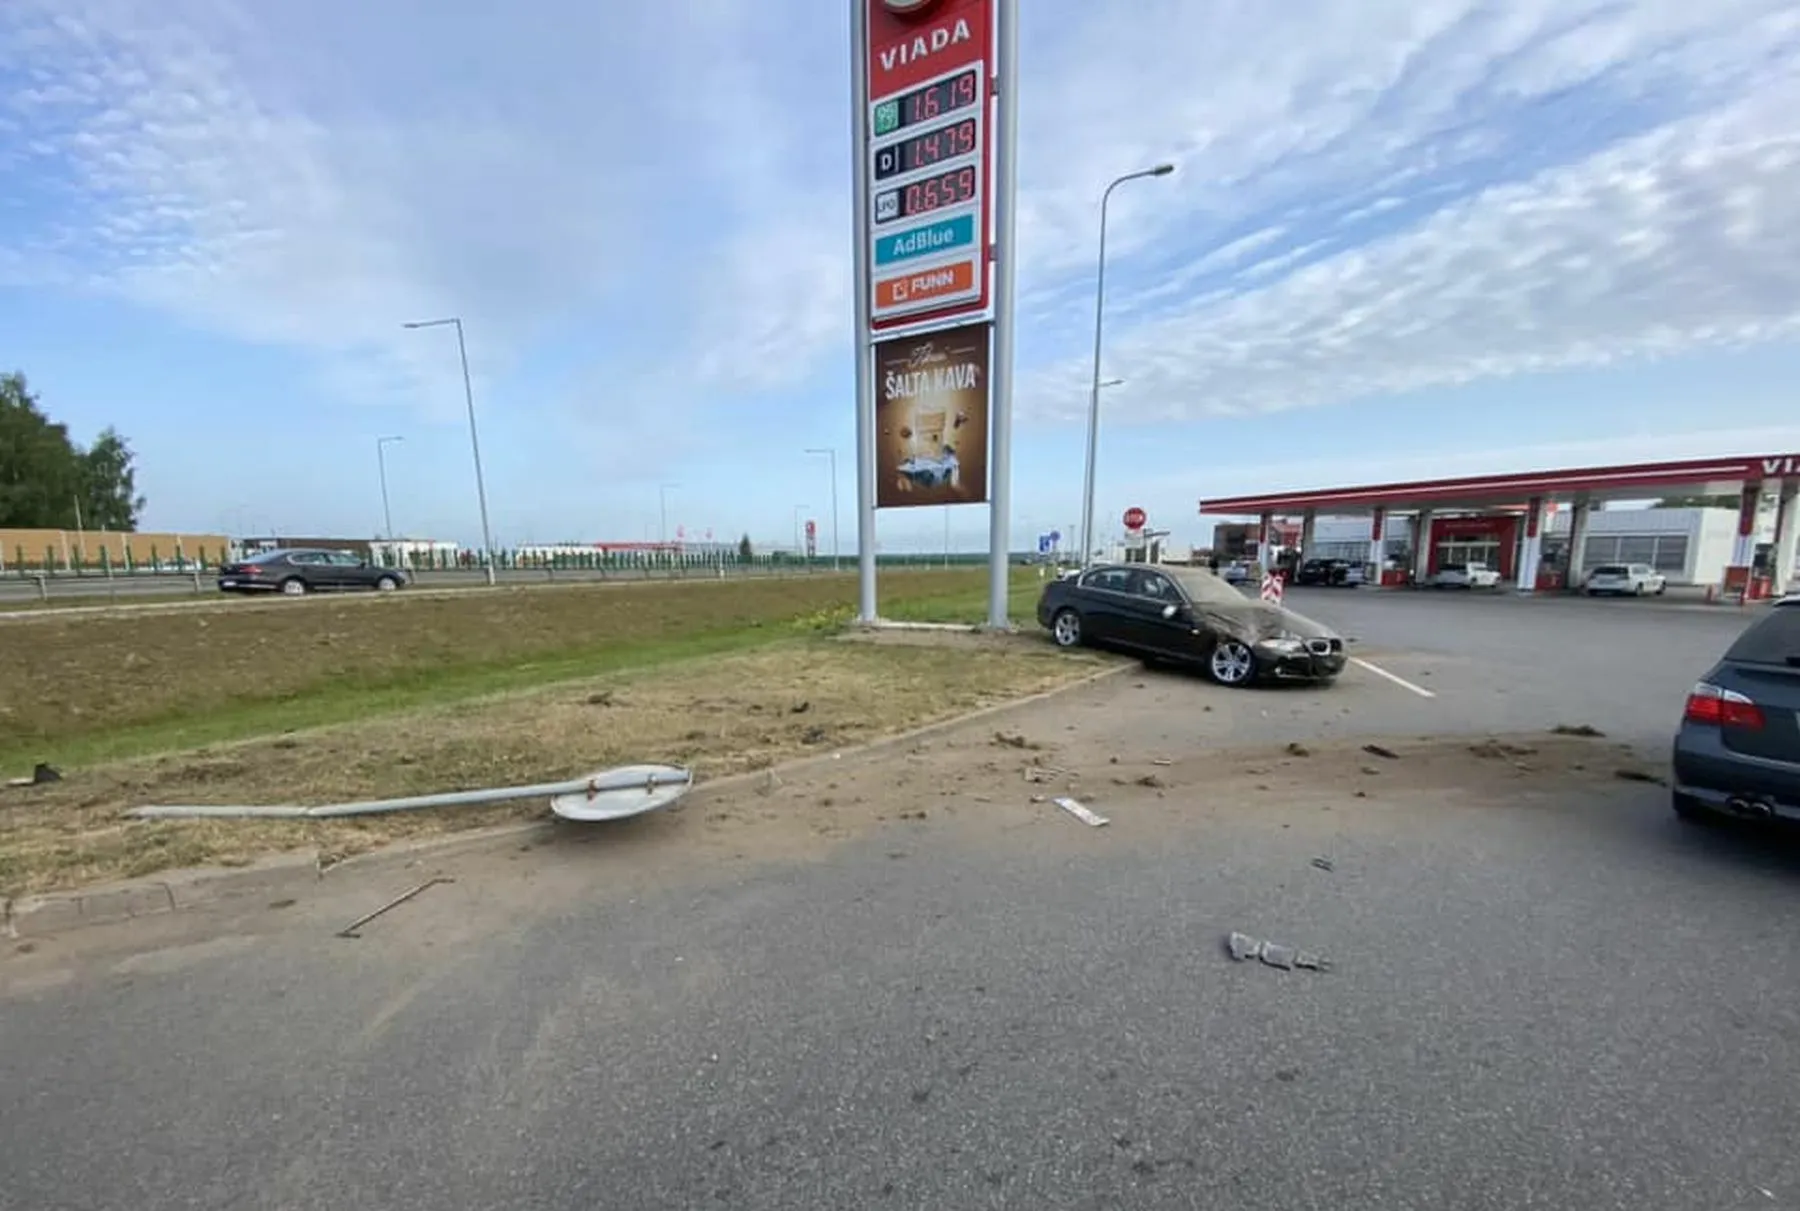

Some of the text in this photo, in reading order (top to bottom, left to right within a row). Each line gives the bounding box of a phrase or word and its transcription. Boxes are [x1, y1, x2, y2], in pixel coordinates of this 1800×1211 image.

[880, 18, 970, 71] VIADA
[881, 153, 893, 171] D
[893, 229, 954, 255] AdBlue
[885, 369, 930, 400] ŠALTA
